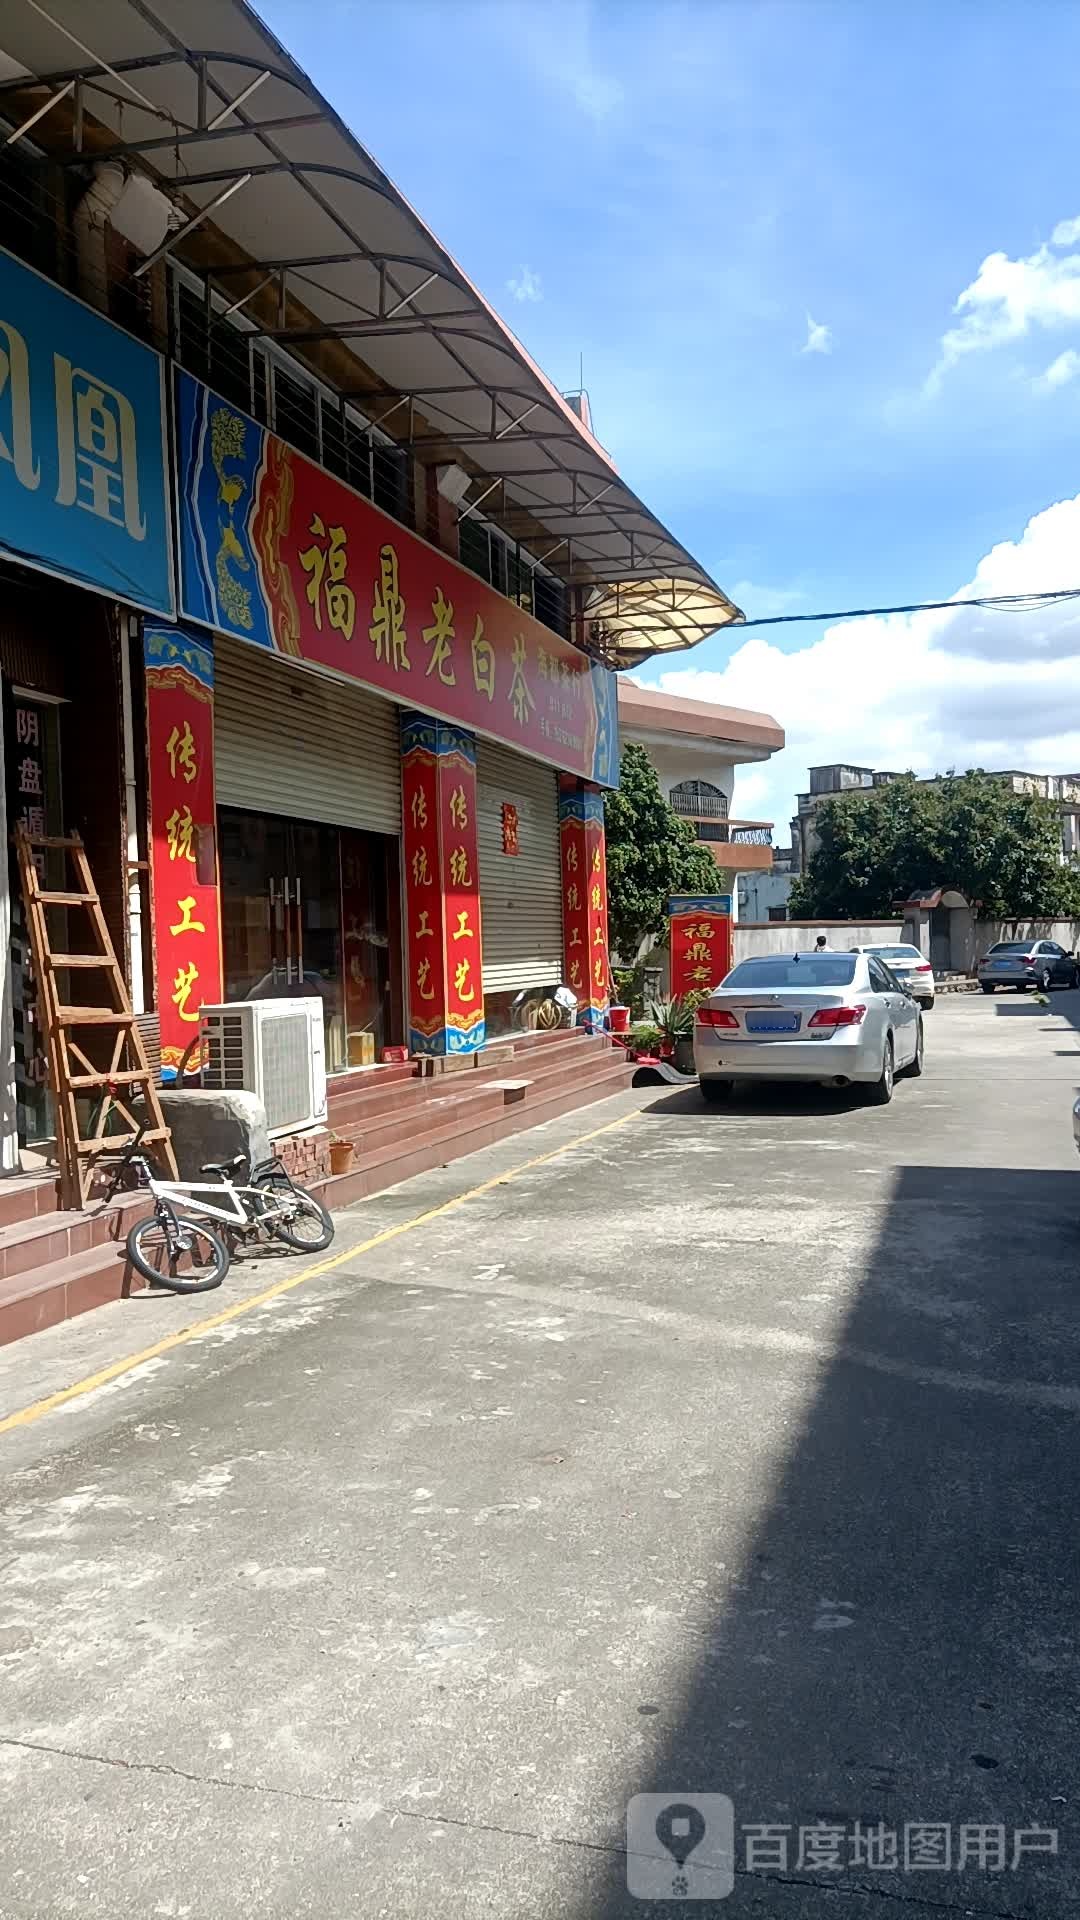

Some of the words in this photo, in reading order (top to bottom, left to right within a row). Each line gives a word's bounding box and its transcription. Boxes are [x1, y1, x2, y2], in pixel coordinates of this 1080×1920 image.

[298, 512, 536, 725] 福鼎老白茶
[166, 721, 206, 1022] 传统工艺
[411, 785, 435, 1000] 传统工艺
[449, 785, 474, 1001] 传统工艺
[567, 842, 583, 989] 传统工艺
[591, 843, 605, 987] 传统工艺
